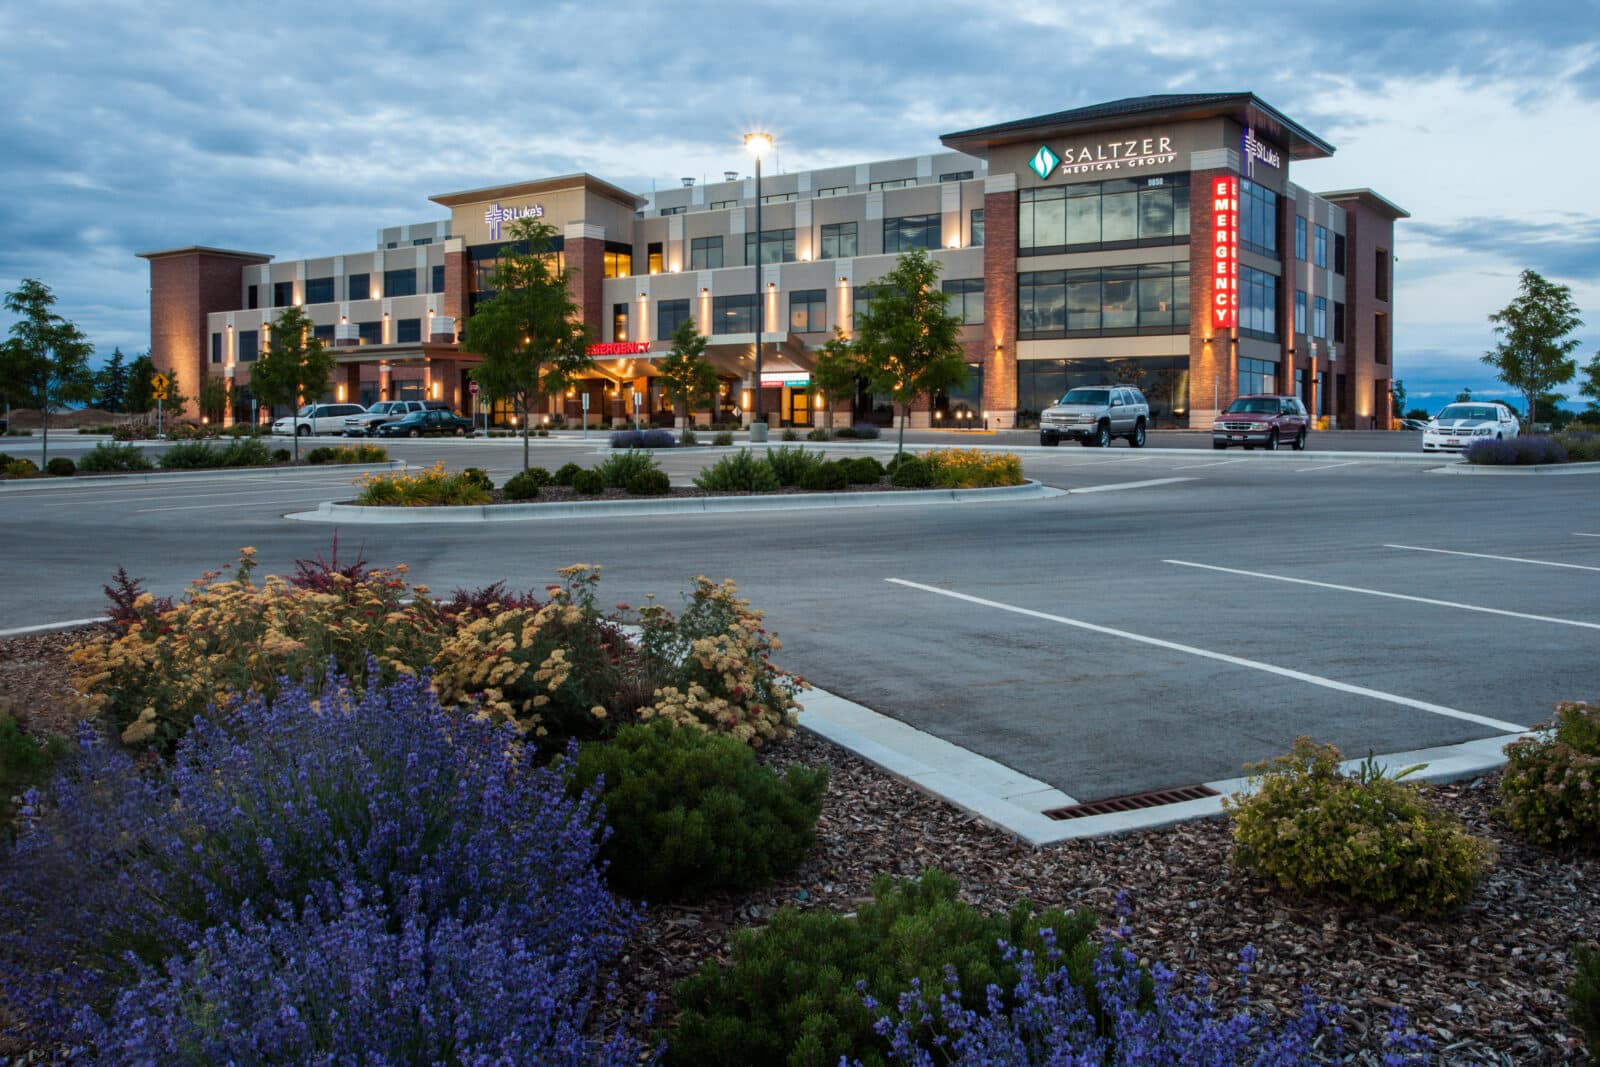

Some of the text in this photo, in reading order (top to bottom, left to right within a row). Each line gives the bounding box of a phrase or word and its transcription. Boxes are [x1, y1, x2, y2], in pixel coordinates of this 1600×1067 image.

[1065, 137, 1172, 163] SALTZER
[1263, 145, 1280, 169] Luke's
[1063, 156, 1174, 175] MEDICAL GROUP
[502, 205, 543, 222] St Luke's
[1215, 183, 1228, 321] EMERGENCY
